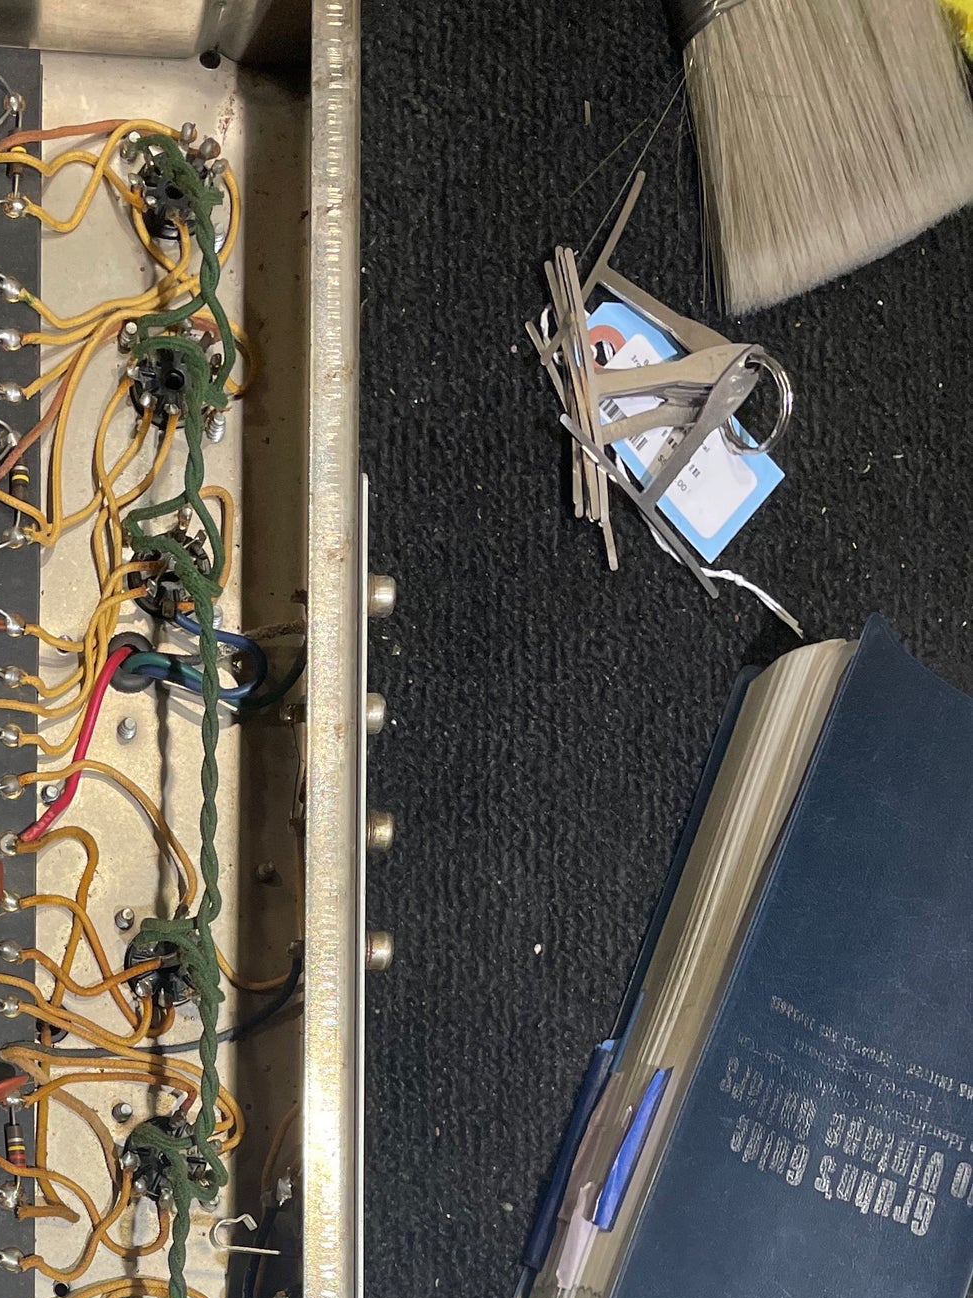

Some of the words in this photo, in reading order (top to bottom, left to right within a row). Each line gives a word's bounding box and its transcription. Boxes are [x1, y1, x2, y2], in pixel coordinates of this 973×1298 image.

[729, 1114, 811, 1187] Guide
[824, 1110, 945, 1195] Vintage
[813, 1154, 936, 1237] Gruhn's
